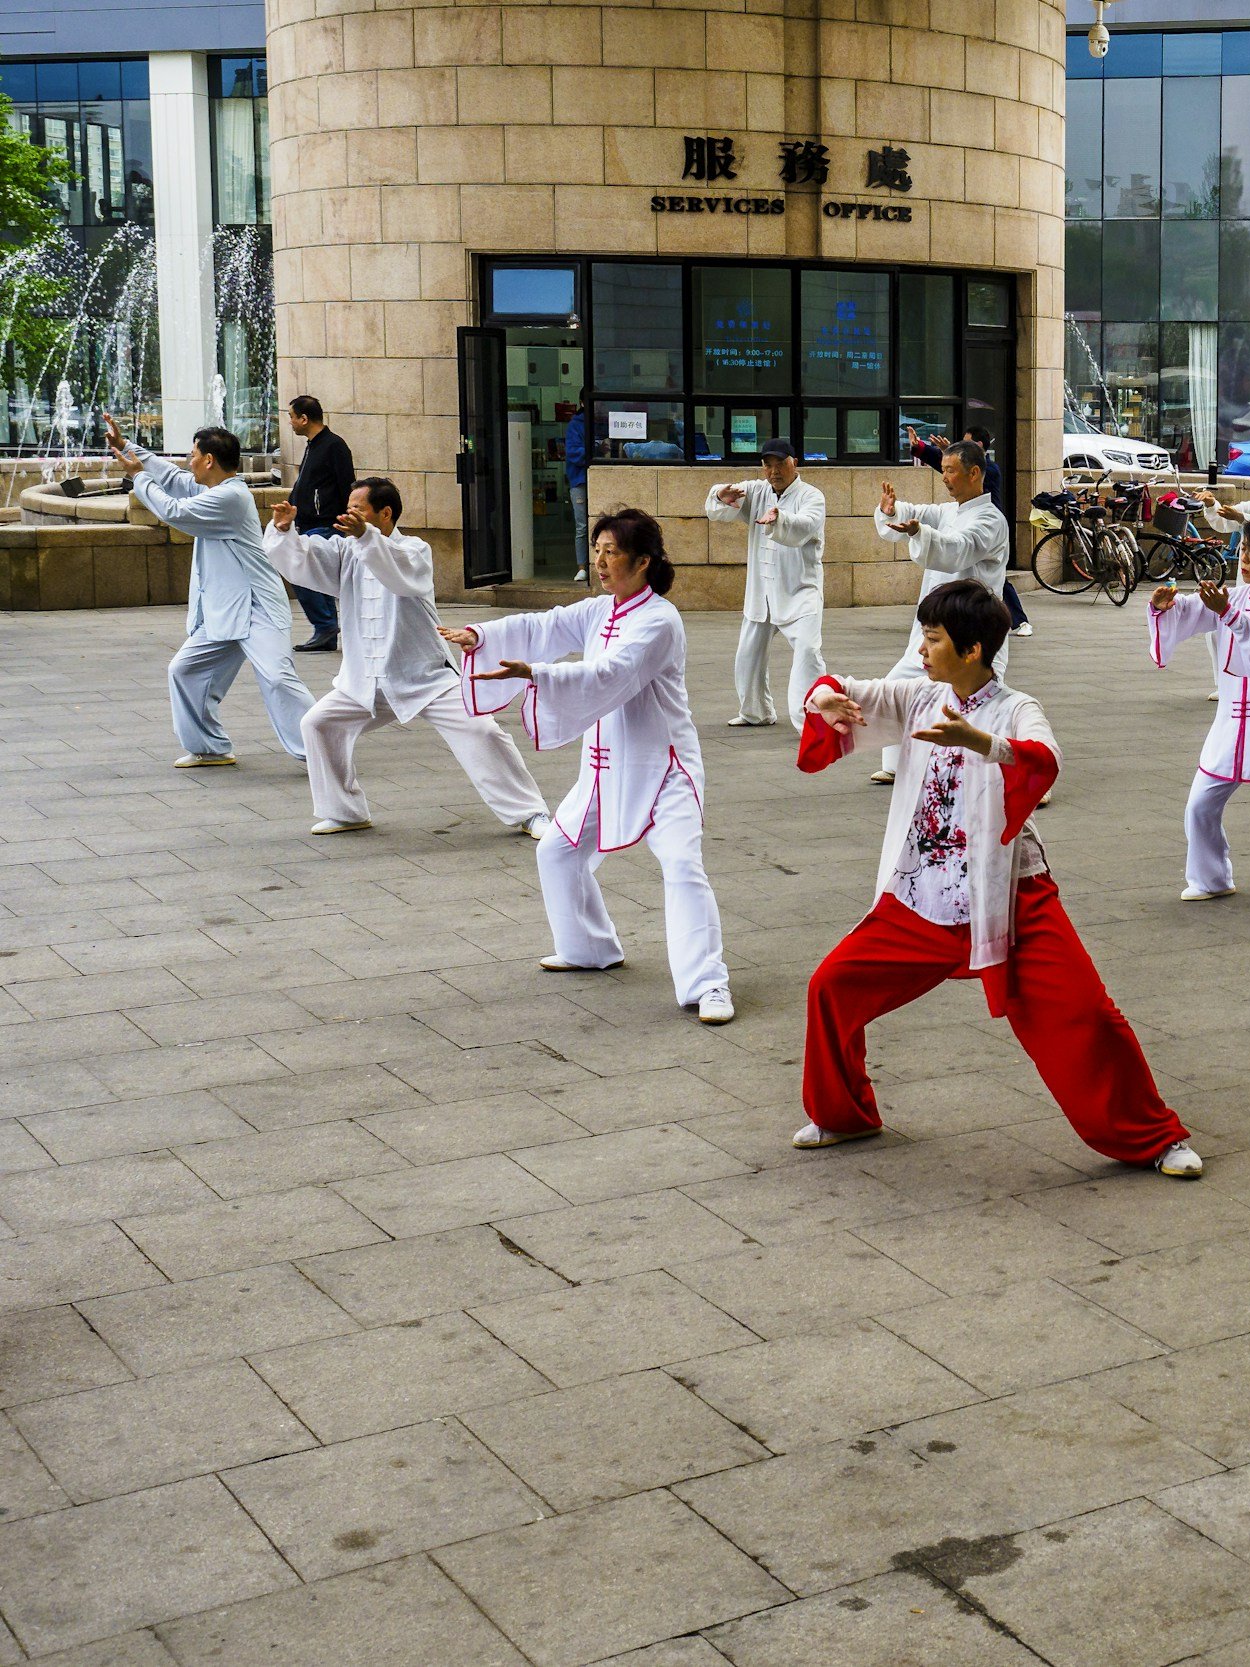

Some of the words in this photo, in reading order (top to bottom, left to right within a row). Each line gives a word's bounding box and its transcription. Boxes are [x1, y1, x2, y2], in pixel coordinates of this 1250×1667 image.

[682, 136, 913, 192] 服務處
[651, 195, 785, 215] SERVICES
[823, 201, 912, 222] OFFICE
[613, 420, 643, 429] 自助存包
